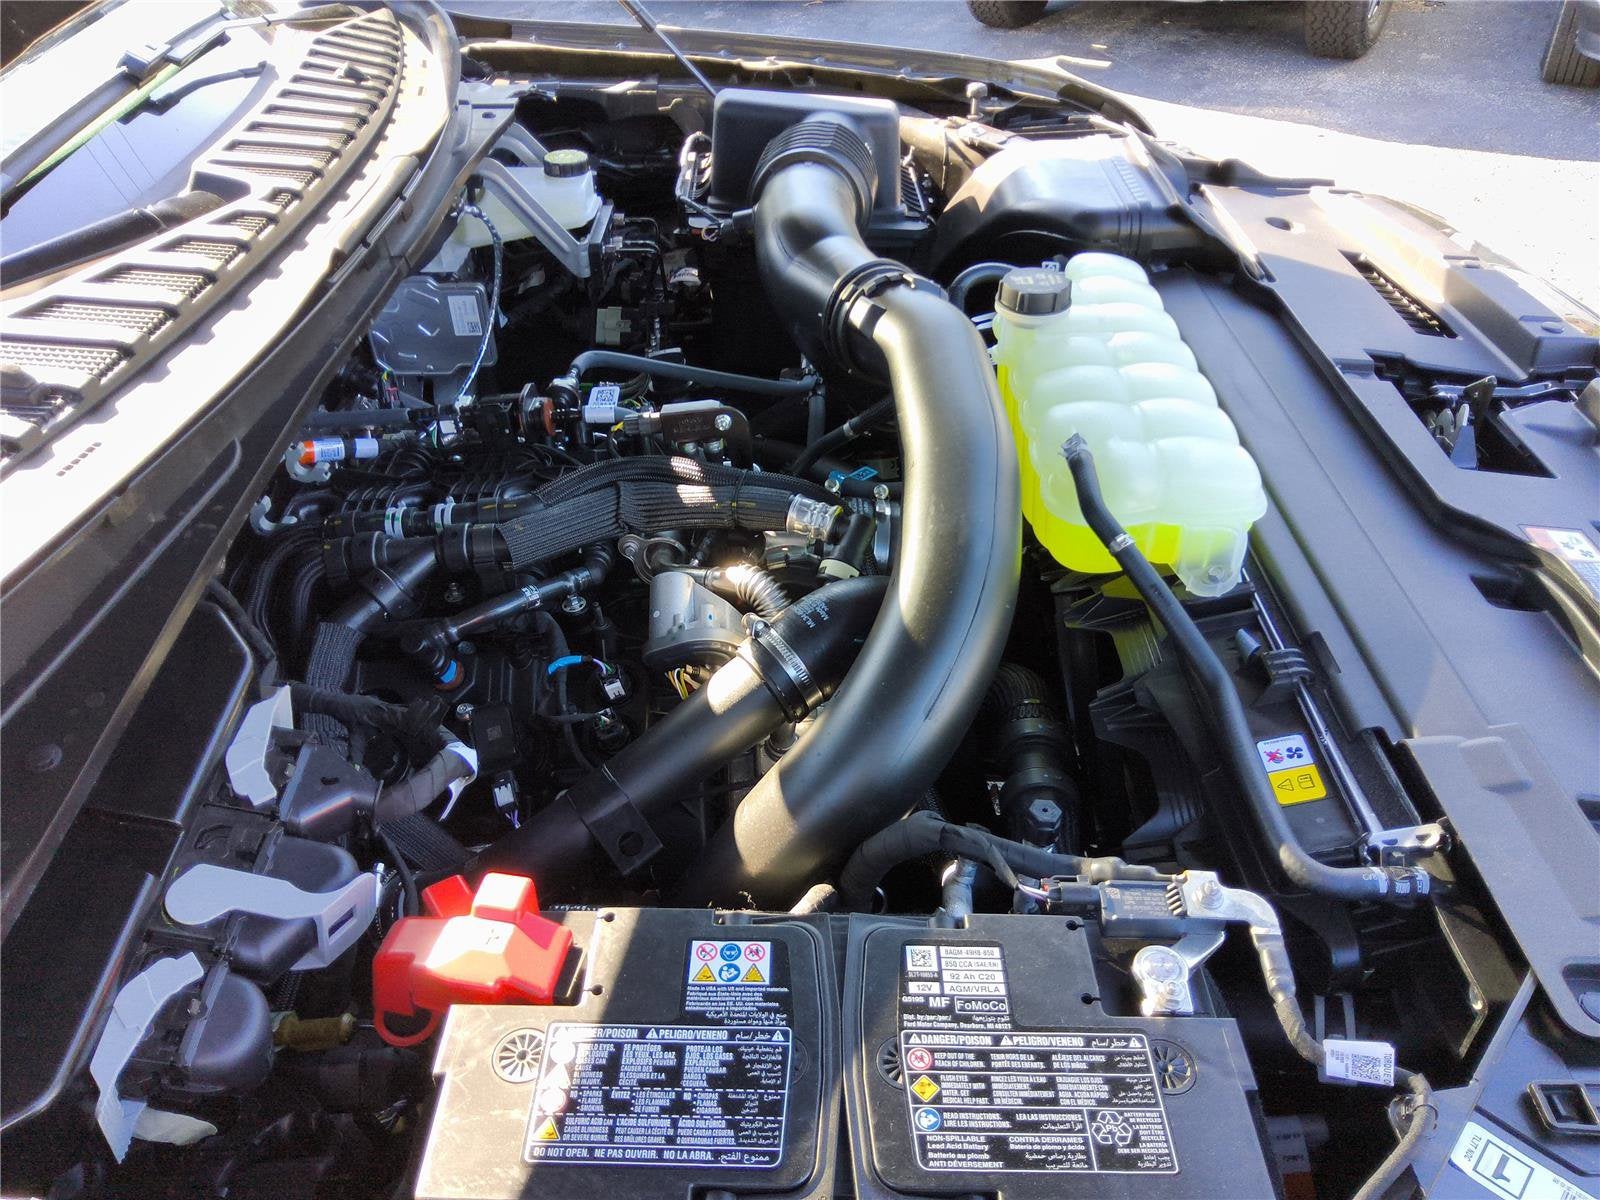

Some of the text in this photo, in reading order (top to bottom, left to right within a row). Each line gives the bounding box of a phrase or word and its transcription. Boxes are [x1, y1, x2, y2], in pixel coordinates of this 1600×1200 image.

[929, 997, 950, 1007] MF
[958, 1001, 1006, 1010] FoMoCo
[659, 1029, 728, 1040] PELIGRO/VENENO
[921, 1034, 992, 1045] DANGER/POISON
[1013, 1036, 1084, 1047] PELIGRO/VENENO
[664, 1051, 675, 1059] GAZ
[534, 1147, 589, 1157] DO NOT OPEN.
[595, 1148, 658, 1158] NE PAS OUVRIR.
[664, 1150, 714, 1160] NO LA ABRA.
[929, 1160, 1004, 1168] ANTI DÉVERSEMENT
